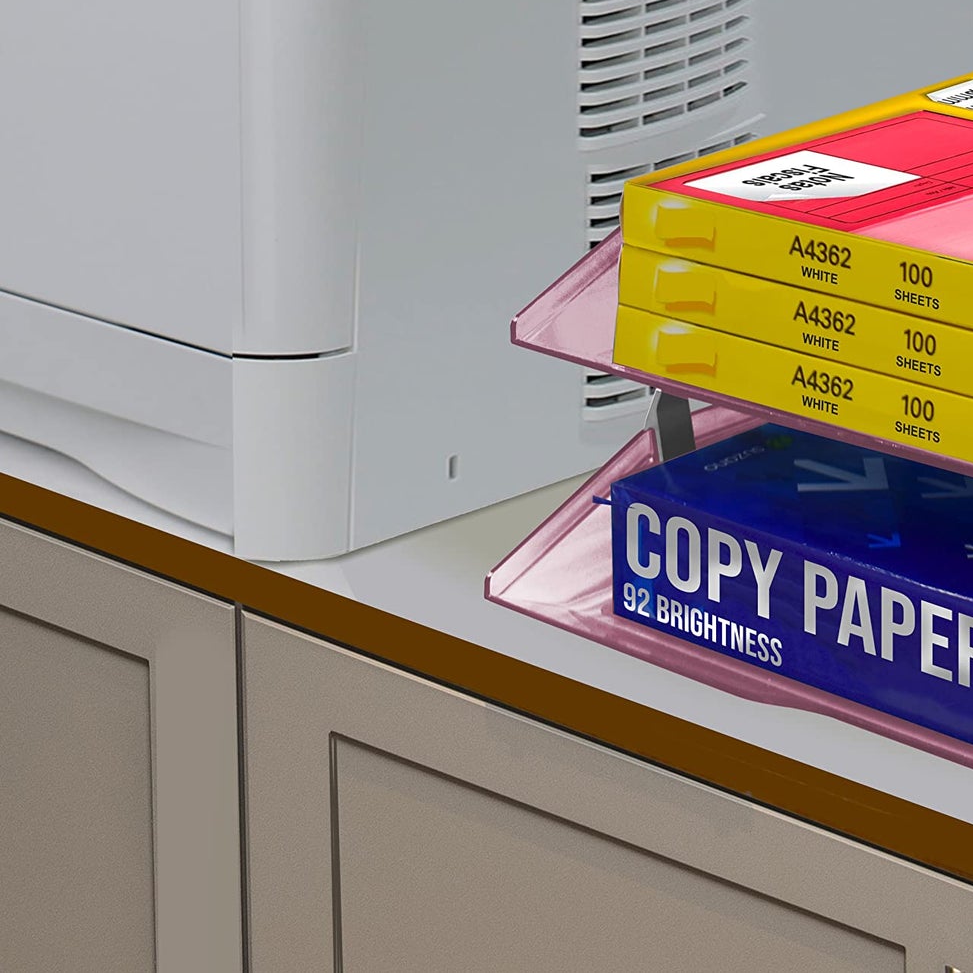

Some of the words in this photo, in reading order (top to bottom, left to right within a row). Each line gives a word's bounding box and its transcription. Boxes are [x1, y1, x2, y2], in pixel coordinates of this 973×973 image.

[742, 164, 830, 186] Fiscais
[778, 172, 855, 191] Notas
[789, 236, 851, 269] A4362
[801, 266, 838, 284] WHITE
[900, 261, 933, 287] 100
[894, 289, 940, 309] SHEETS
[793, 301, 855, 335] A4362
[802, 333, 839, 351] WHITE
[904, 329, 936, 355] 100
[896, 355, 941, 376] SHEETS
[791, 366, 853, 400] A4362
[802, 395, 839, 415] WHITE
[901, 395, 934, 421] 100
[895, 421, 940, 442] SHEETS
[626, 502, 782, 620] COPY
[623, 582, 650, 618] 92
[656, 595, 782, 667] BRIGHTNESS
